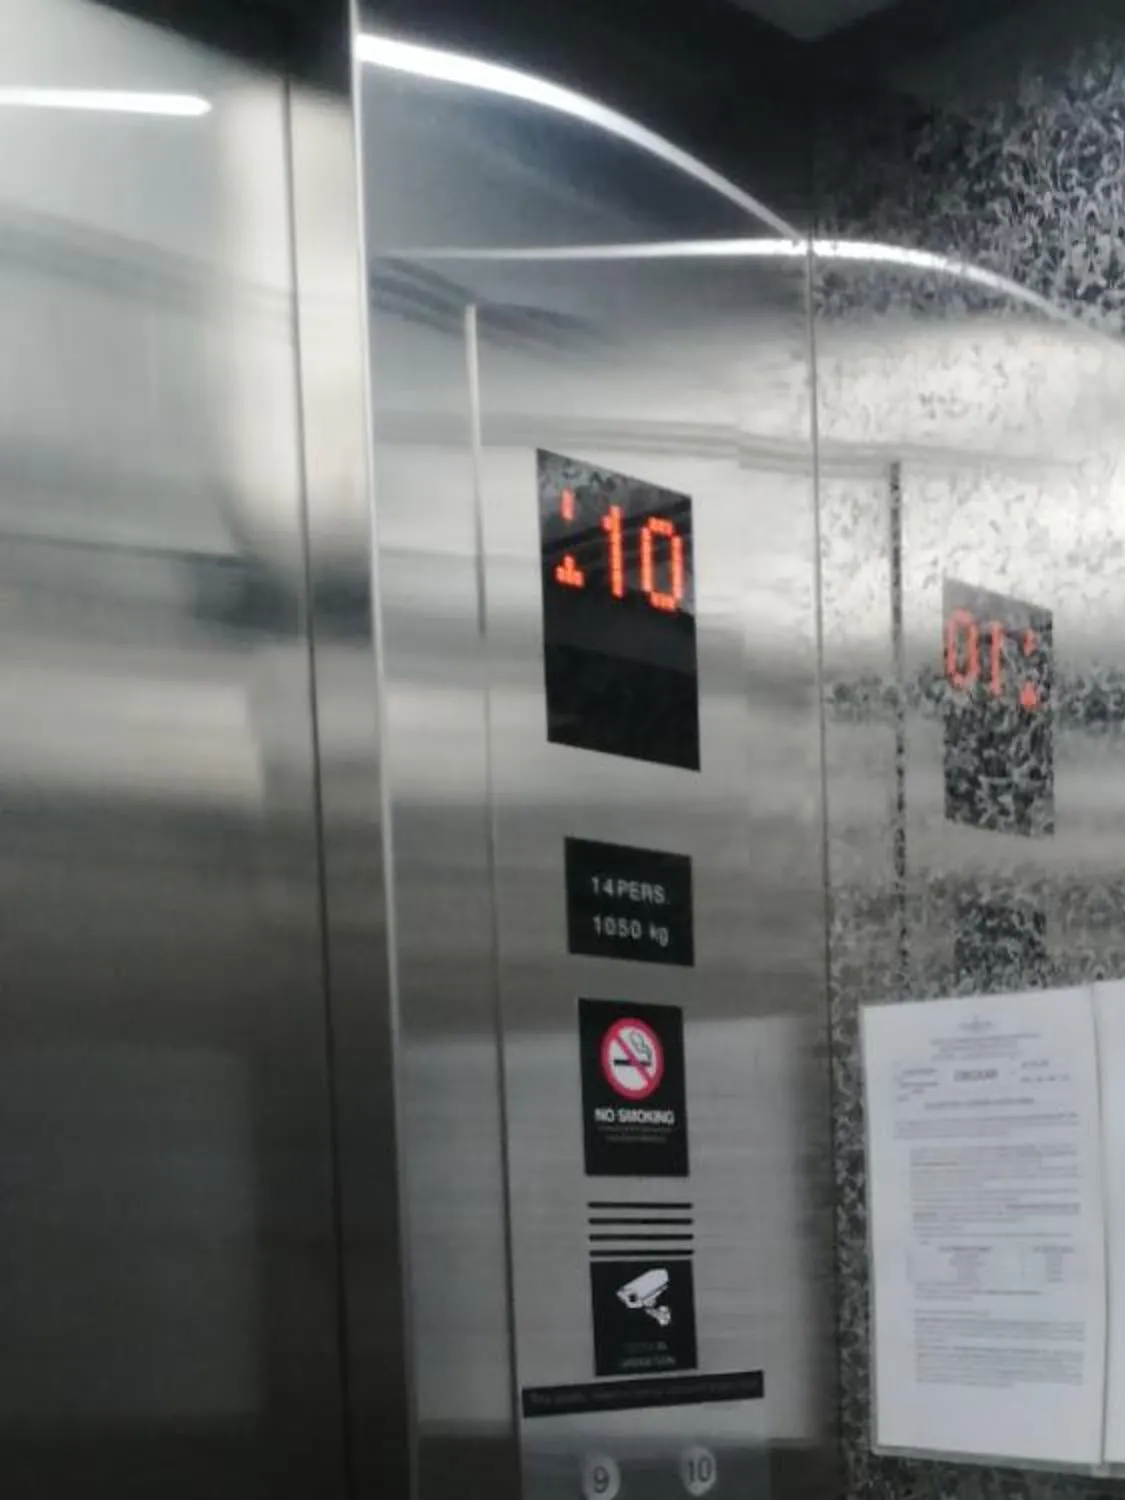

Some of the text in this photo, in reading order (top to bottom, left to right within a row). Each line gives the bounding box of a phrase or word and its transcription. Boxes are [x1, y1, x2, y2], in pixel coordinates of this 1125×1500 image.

[602, 504, 684, 613] 10
[594, 1107, 676, 1126] NO SMOKING
[593, 1456, 713, 1494] 9 10
